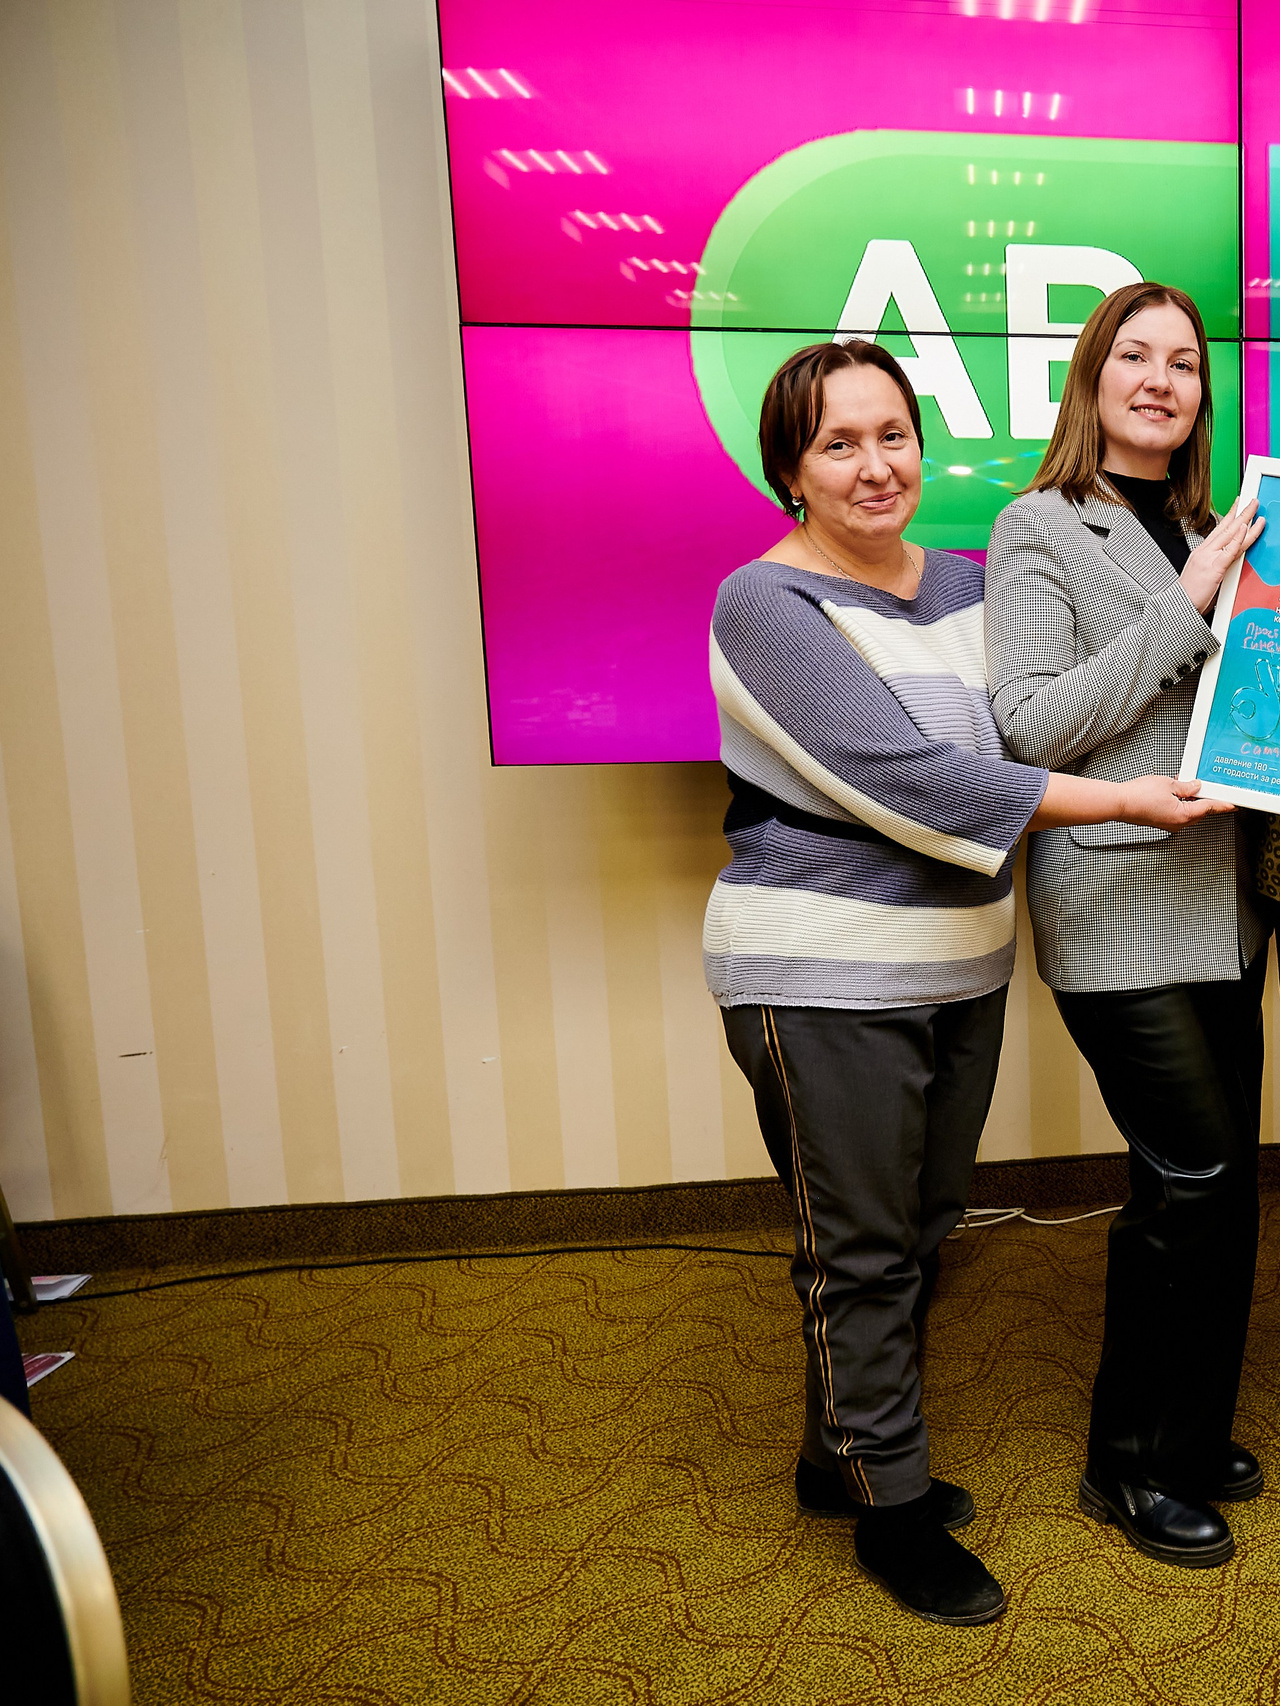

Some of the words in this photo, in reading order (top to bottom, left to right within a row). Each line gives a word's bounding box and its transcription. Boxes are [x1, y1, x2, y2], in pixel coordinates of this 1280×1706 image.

[1214, 756, 1252, 769] давление
[1254, 761, 1268, 772] 180
[1223, 767, 1259, 781] гордости
